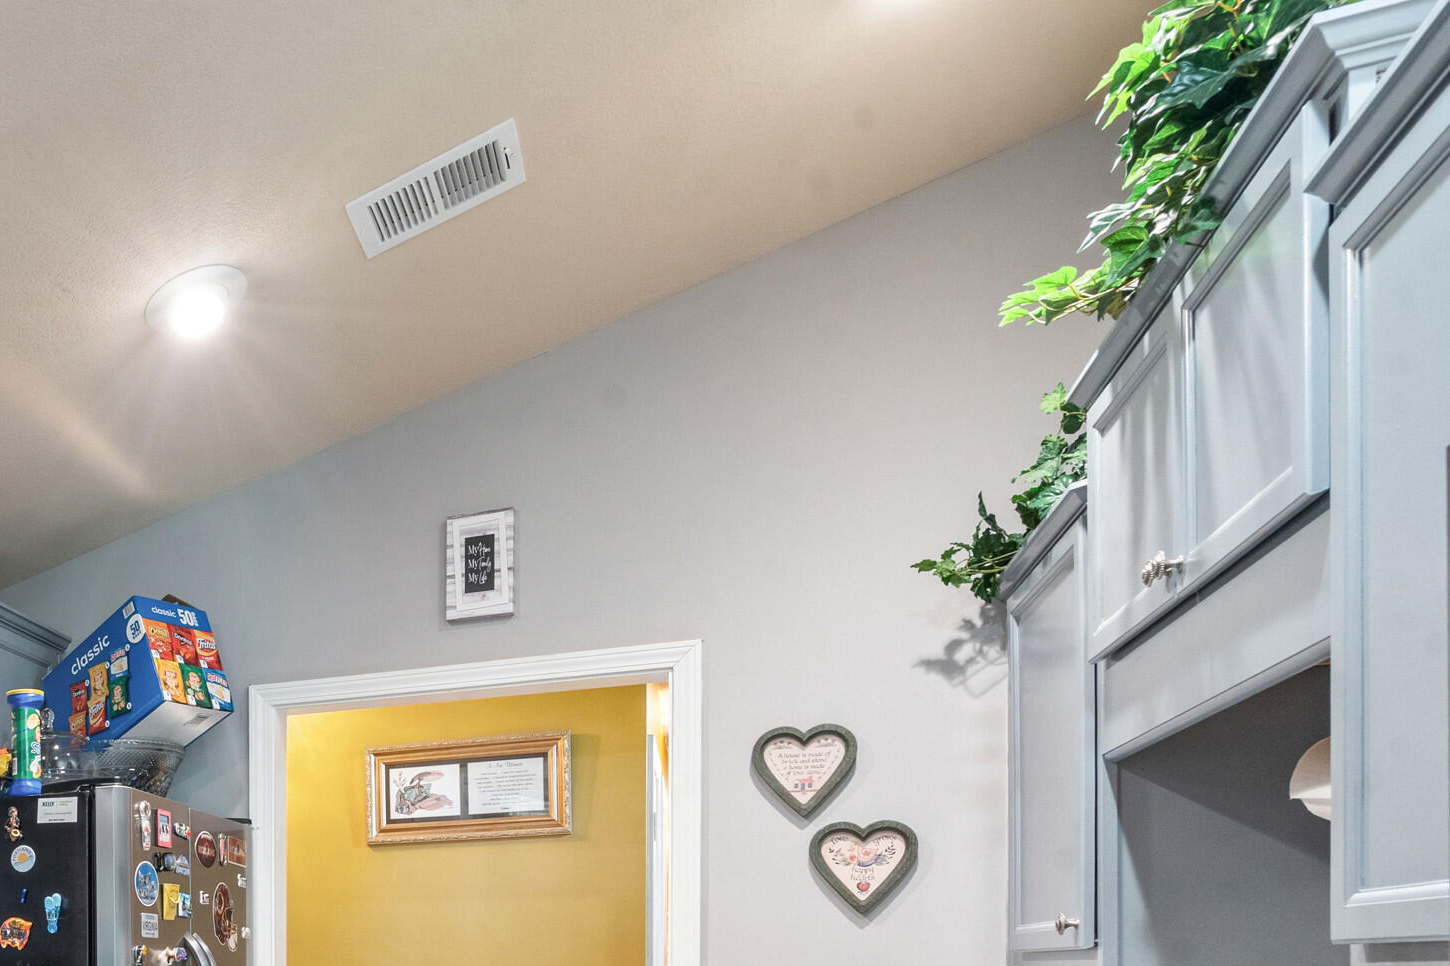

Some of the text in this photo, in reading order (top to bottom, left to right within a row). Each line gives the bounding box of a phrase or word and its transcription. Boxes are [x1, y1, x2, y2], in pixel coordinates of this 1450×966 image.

[468, 544, 478, 556] My
[468, 559, 478, 570] My
[468, 573, 478, 584] My
[151, 606, 177, 618] classic
[177, 608, 194, 627] 50
[71, 635, 110, 675] classic
